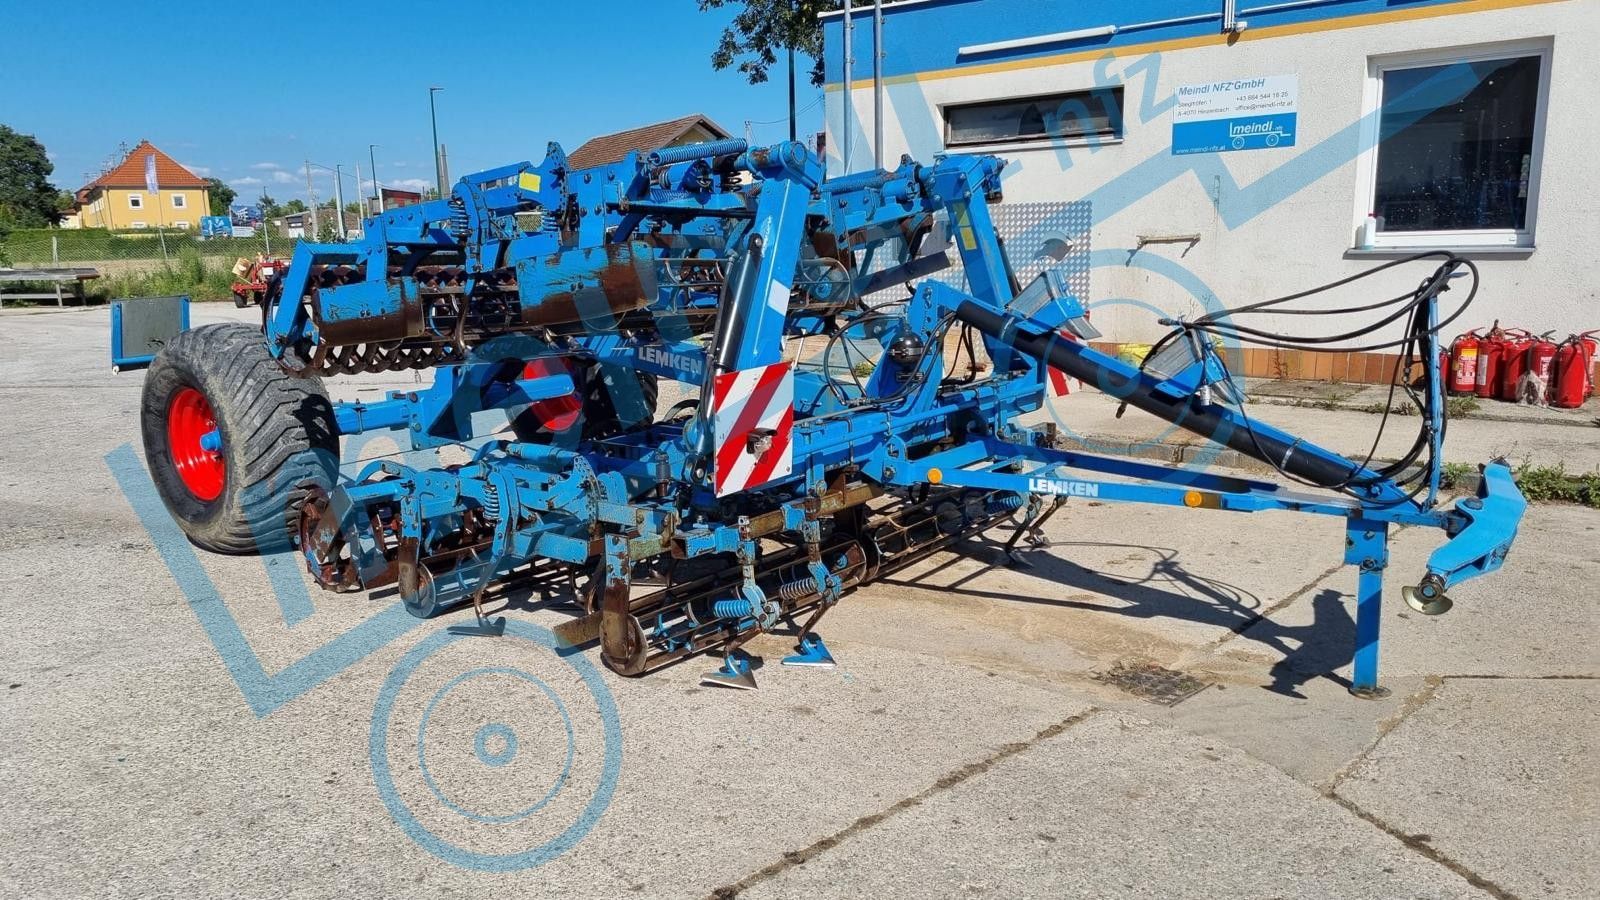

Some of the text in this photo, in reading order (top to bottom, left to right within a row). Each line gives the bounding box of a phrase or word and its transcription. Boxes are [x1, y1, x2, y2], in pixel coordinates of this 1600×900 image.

[1178, 78, 1265, 96] Meindl NFZ GmbH
[1232, 120, 1273, 135] meindl
[1175, 144, 1226, 154] www.meindl-nfz.at
[638, 346, 703, 375] LEMKEN
[1028, 478, 1099, 497] LEMKEN
